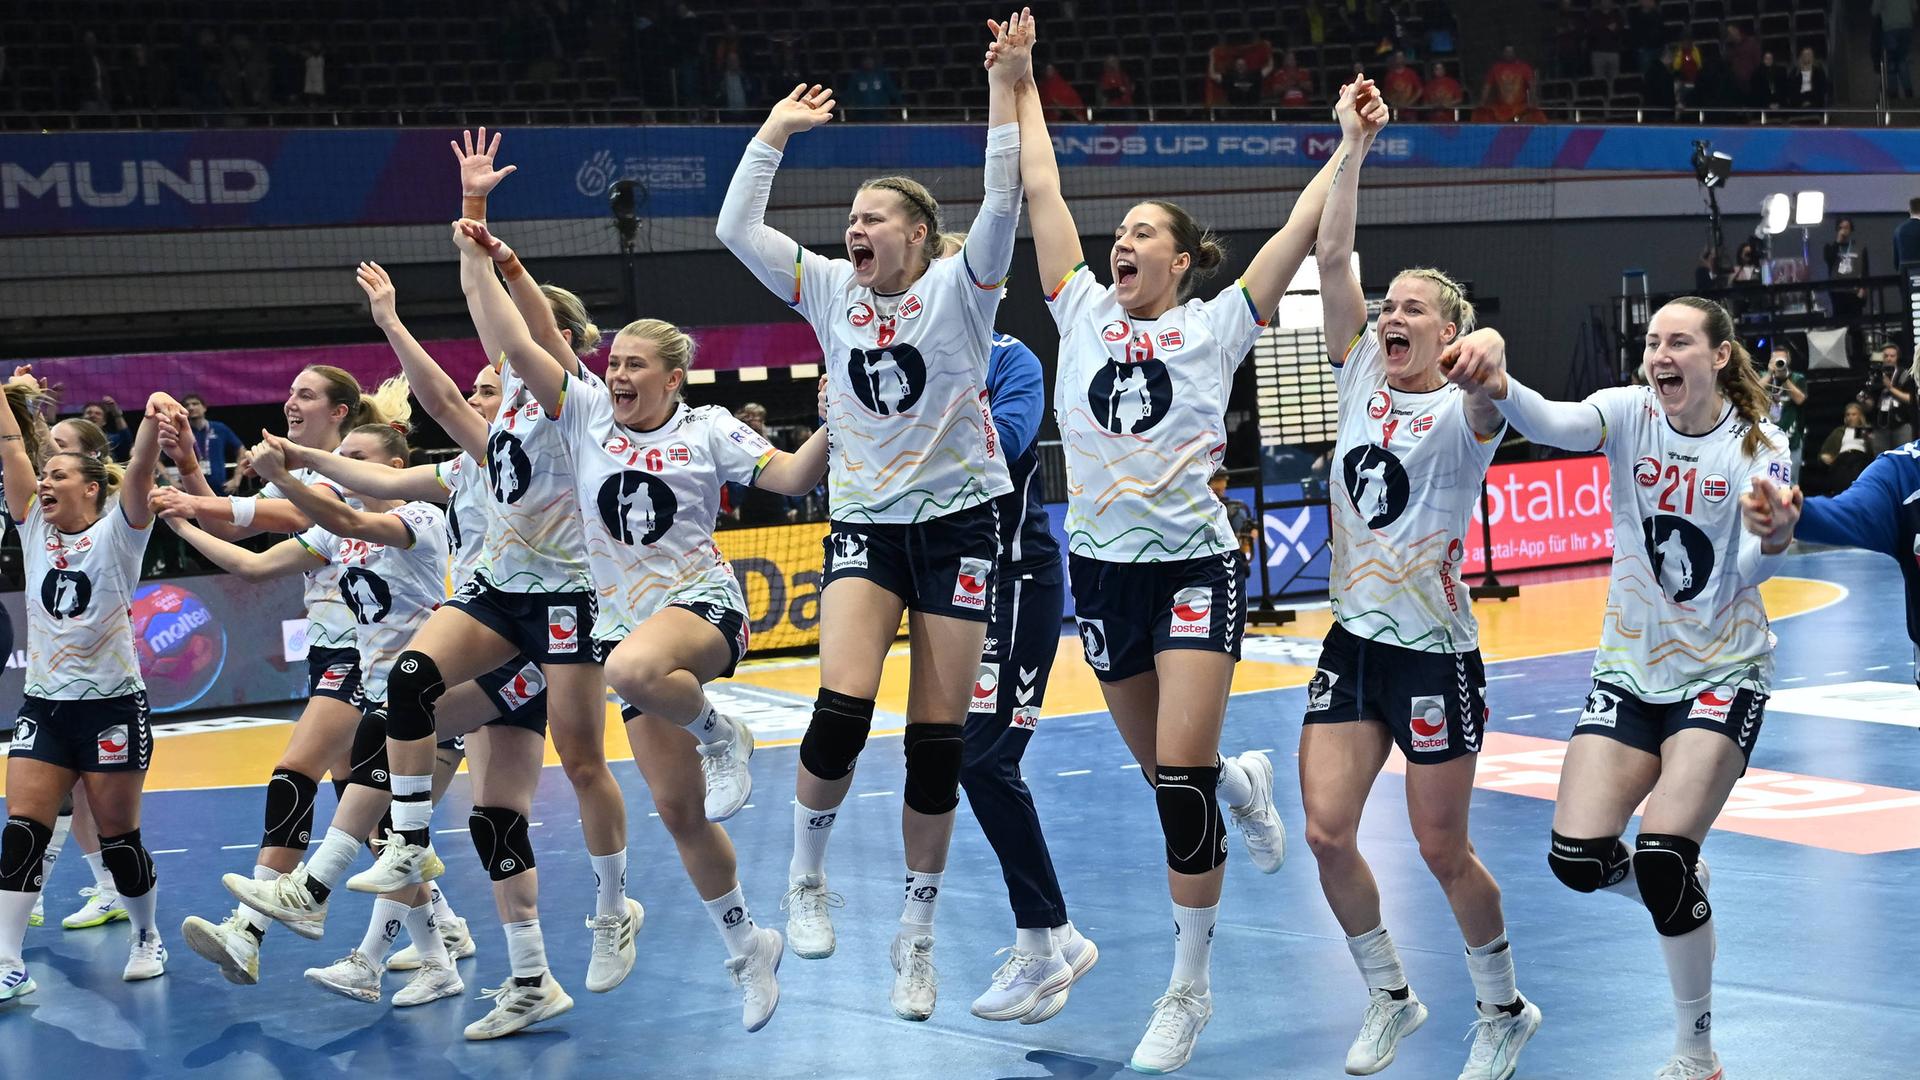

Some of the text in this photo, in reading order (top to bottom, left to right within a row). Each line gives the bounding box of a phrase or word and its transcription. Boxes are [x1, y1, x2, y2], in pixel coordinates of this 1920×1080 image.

[1156, 137, 1208, 155] UP
[1217, 136, 1297, 155] FOR
[1307, 137, 1409, 156] MRE
[1, 159, 270, 209] MUND
[1658, 465, 1698, 514] 21
[1549, 531, 1567, 552] für
[1571, 532, 1588, 550] Ihr
[954, 593, 986, 607] posten
[150, 607, 212, 654] molten
[1170, 623, 1209, 635] posten
[549, 641, 577, 650] posten
[1690, 706, 1726, 719] posten
[1412, 737, 1447, 749] posten
